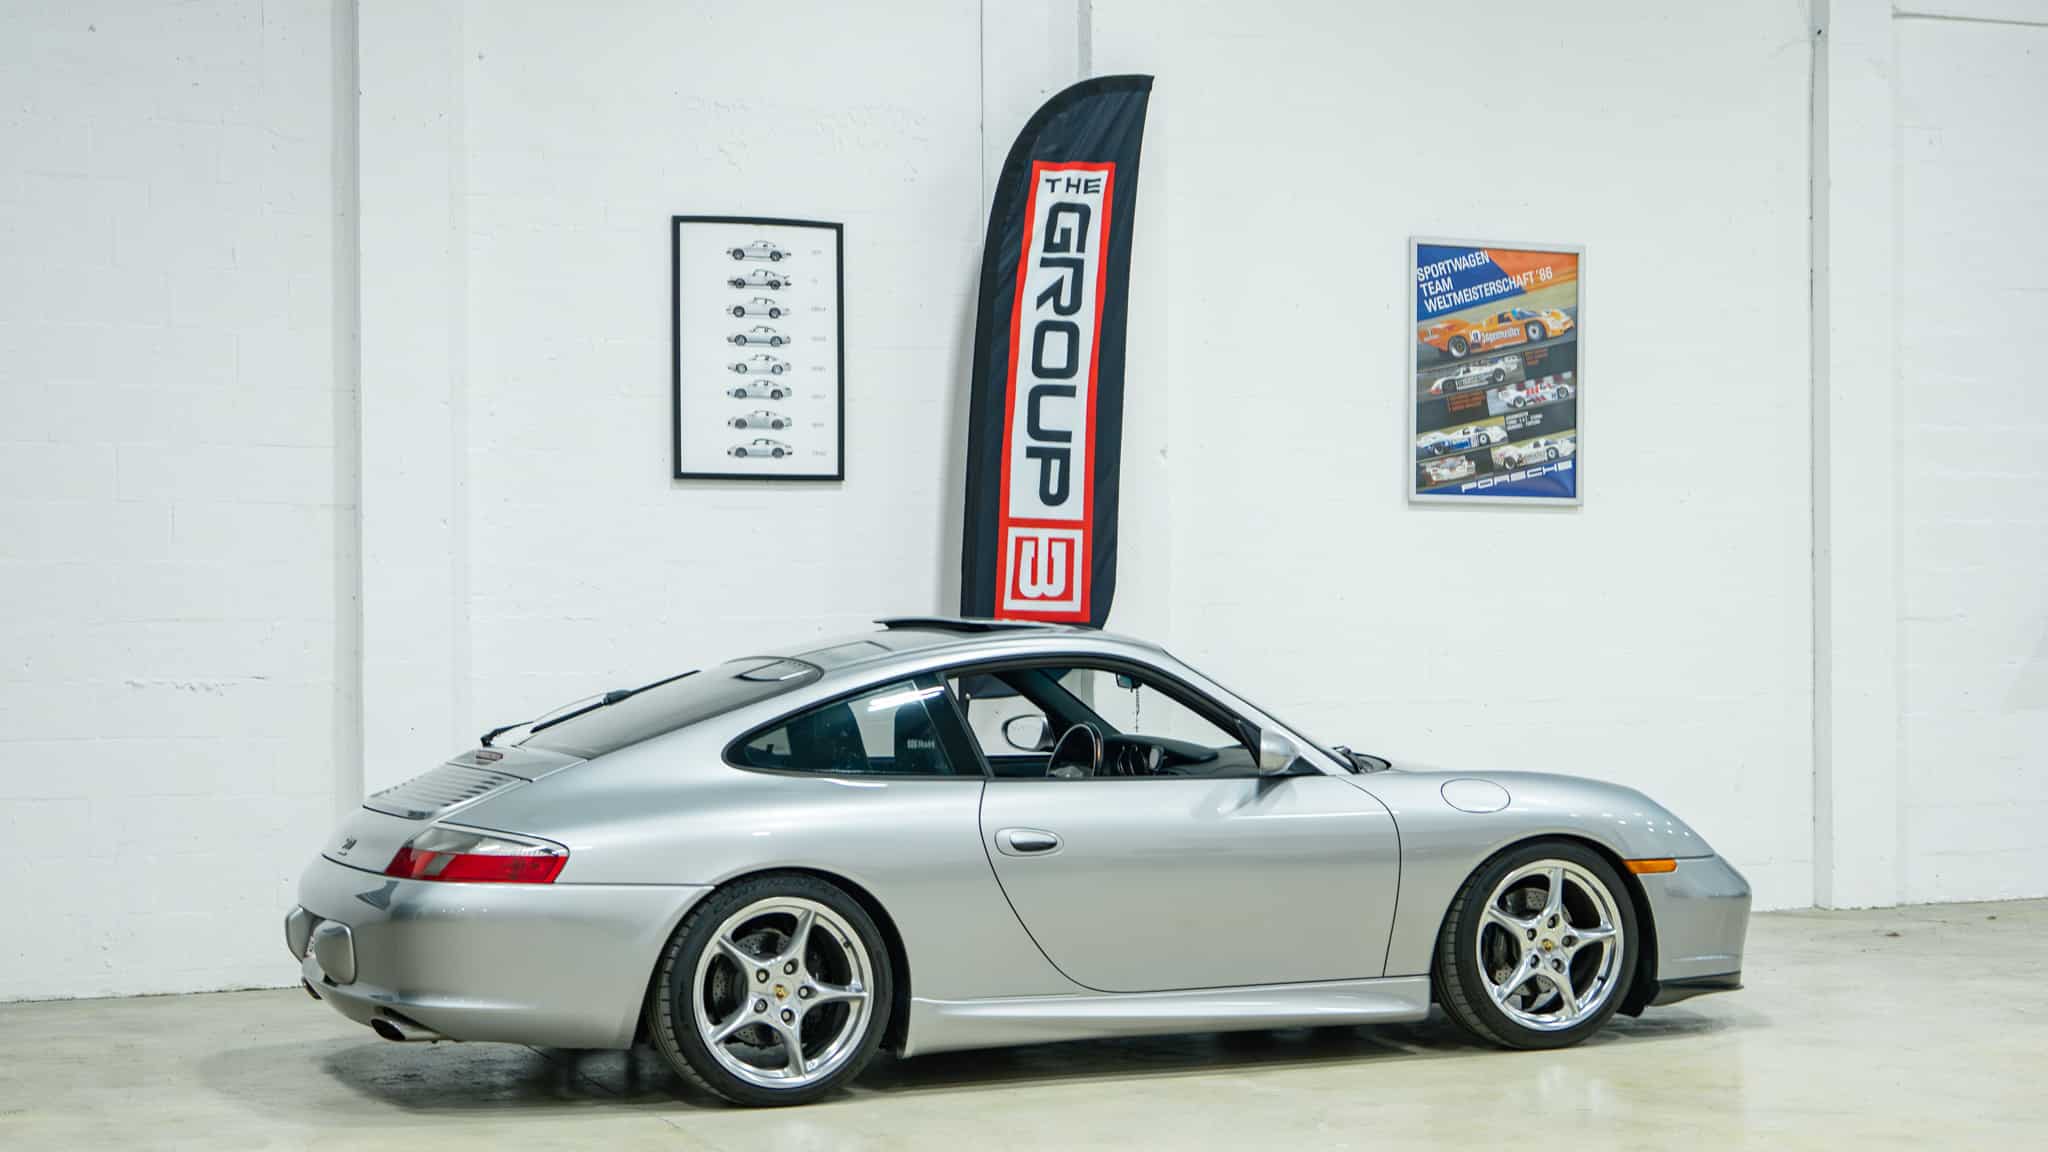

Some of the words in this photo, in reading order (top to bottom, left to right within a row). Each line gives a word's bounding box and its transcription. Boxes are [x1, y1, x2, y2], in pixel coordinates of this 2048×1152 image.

[1045, 177, 1102, 194] THE
[1417, 250, 1491, 281] SPORTWAGEN
[1420, 276, 1454, 297] TEAM
[1424, 271, 1535, 313] WELTMEISTERSCHAFT
[1025, 202, 1091, 507] GROUP
[1461, 460, 1573, 493] PORSCHE
[1017, 539, 1068, 599] 3
